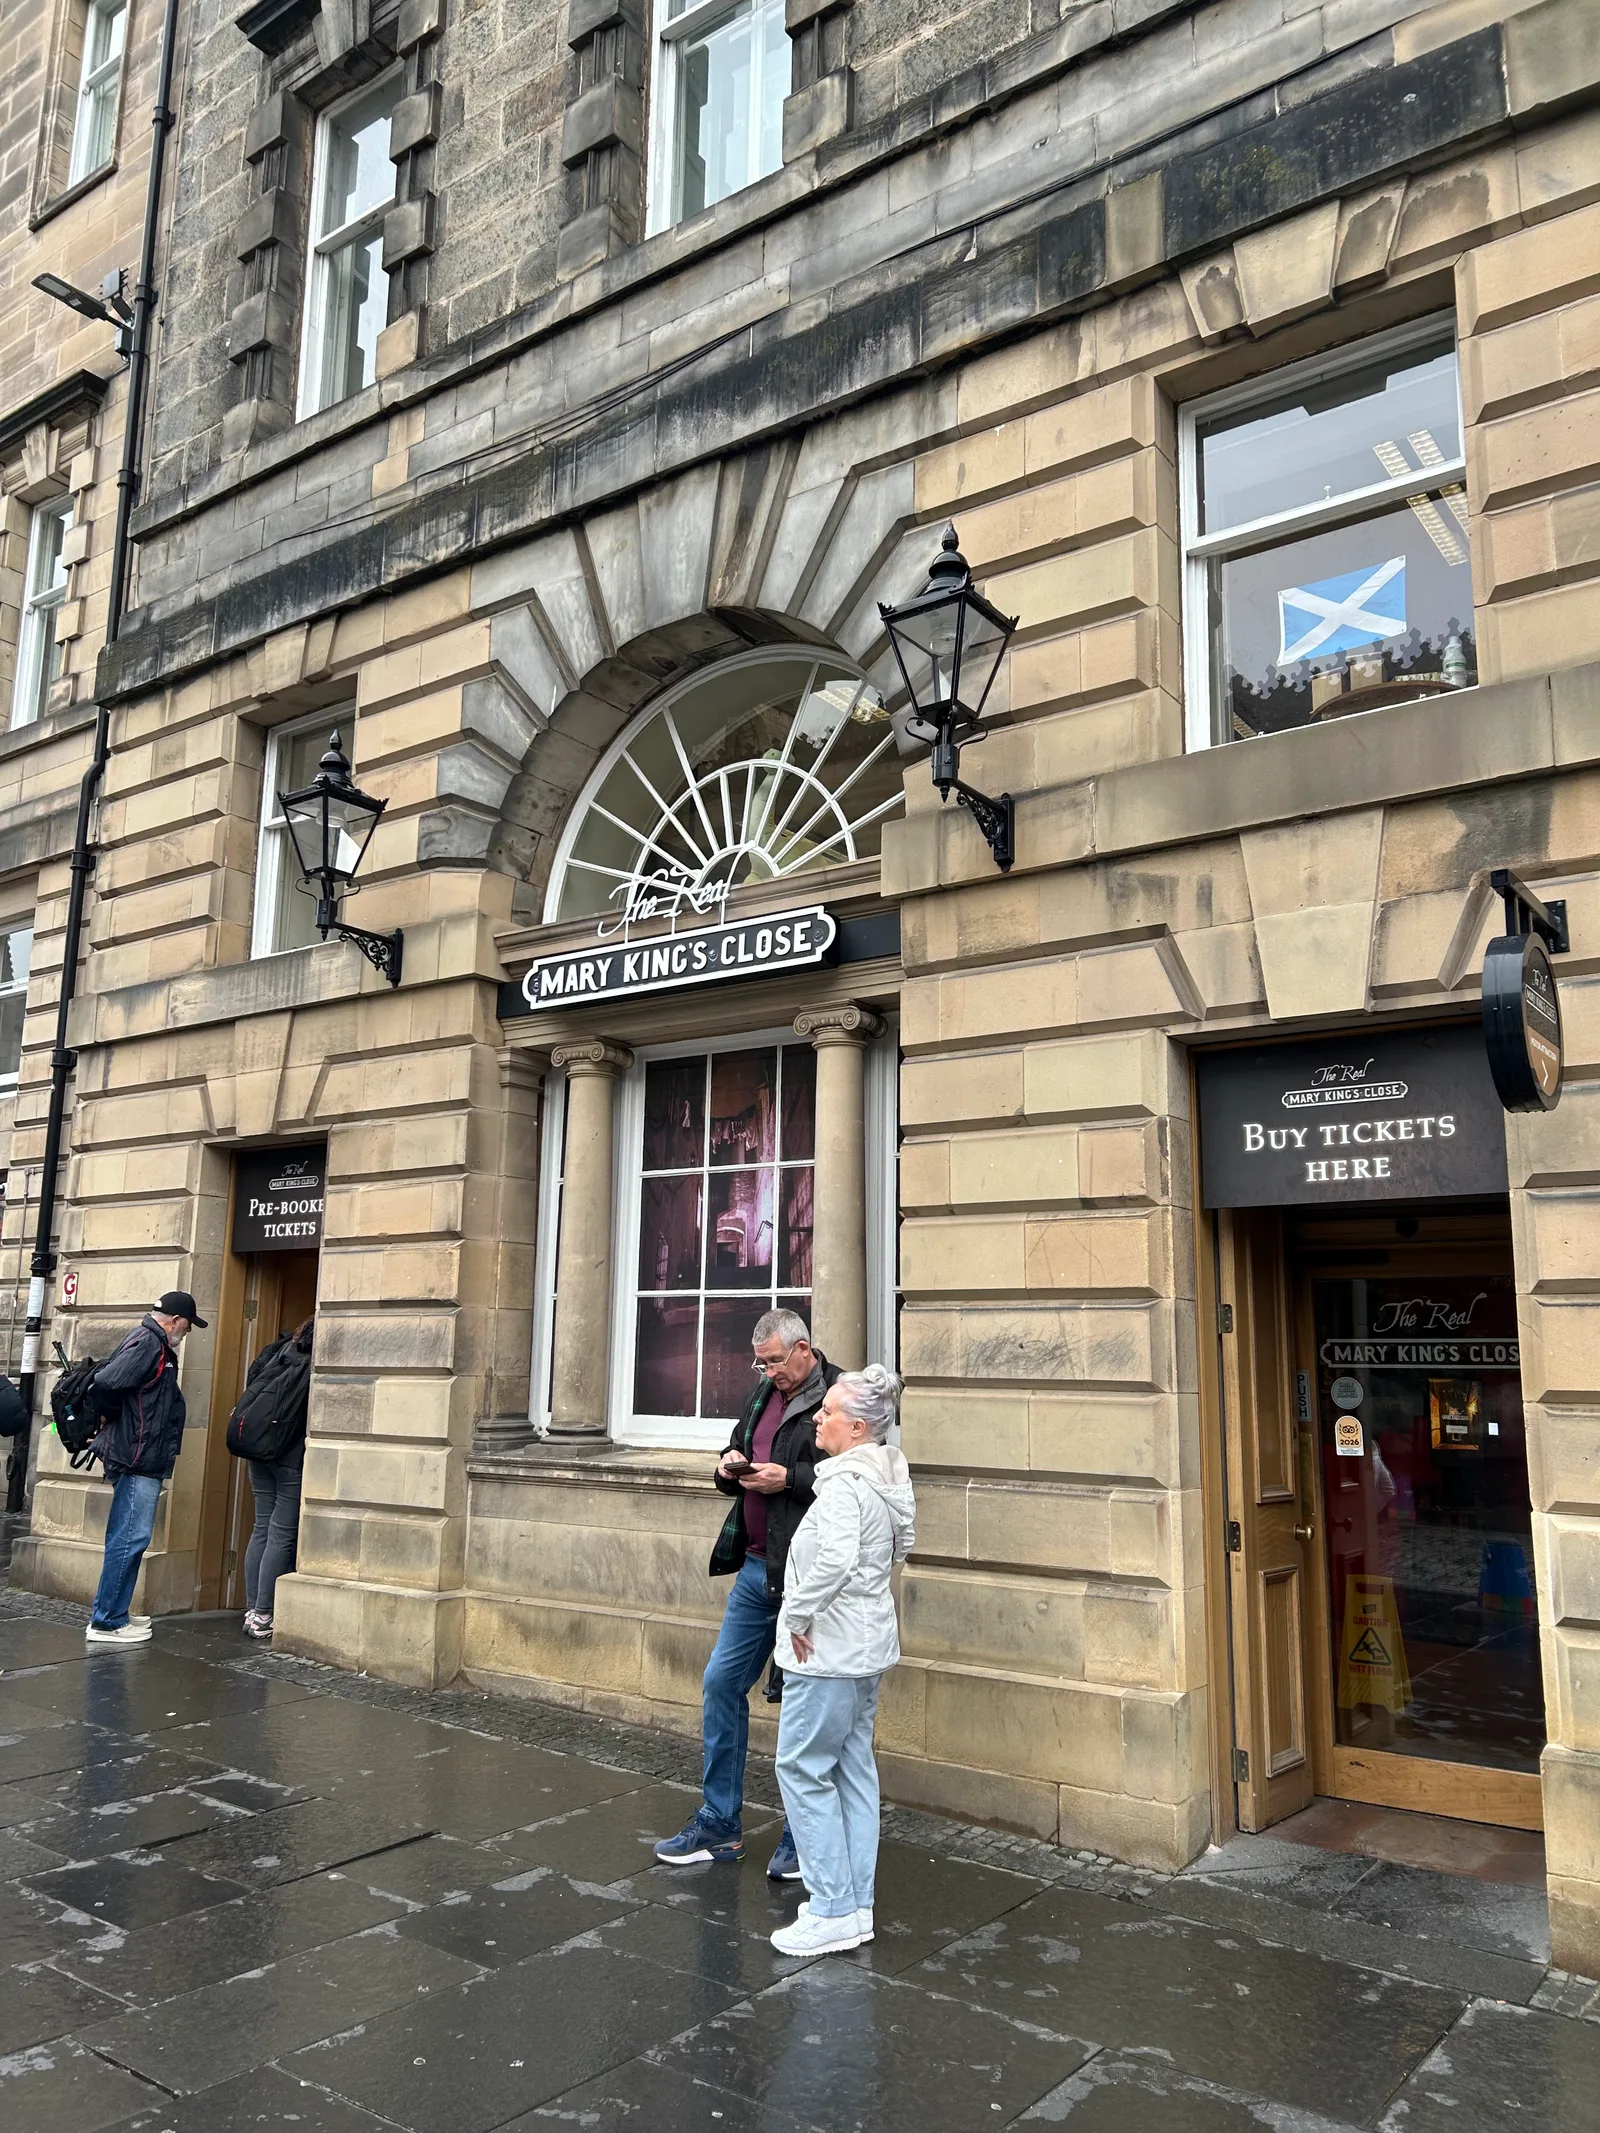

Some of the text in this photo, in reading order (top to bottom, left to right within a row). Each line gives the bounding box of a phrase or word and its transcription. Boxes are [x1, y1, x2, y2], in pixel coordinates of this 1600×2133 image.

[598, 840, 758, 938] The Real
[540, 921, 812, 996] MARY KING'S CLOSE
[1311, 1057, 1374, 1086] The Real
[1289, 1085, 1400, 1105] MARY KING'S CLOSE
[1319, 1115, 1456, 1146] TICKETS
[1305, 1156, 1391, 1182] HERE
[249, 1198, 324, 1216] PRE-BOOKE
[264, 1221, 316, 1237] TICKETS
[64, 1273, 76, 1295] G
[1373, 1292, 1488, 1333] The Real
[1334, 1344, 1519, 1364] MARY KING'S CLOS
[1297, 1374, 1308, 1418] PUSH
[1353, 1616, 1389, 1628] CAUTION
[1349, 1663, 1393, 1677] WET FLOOR
